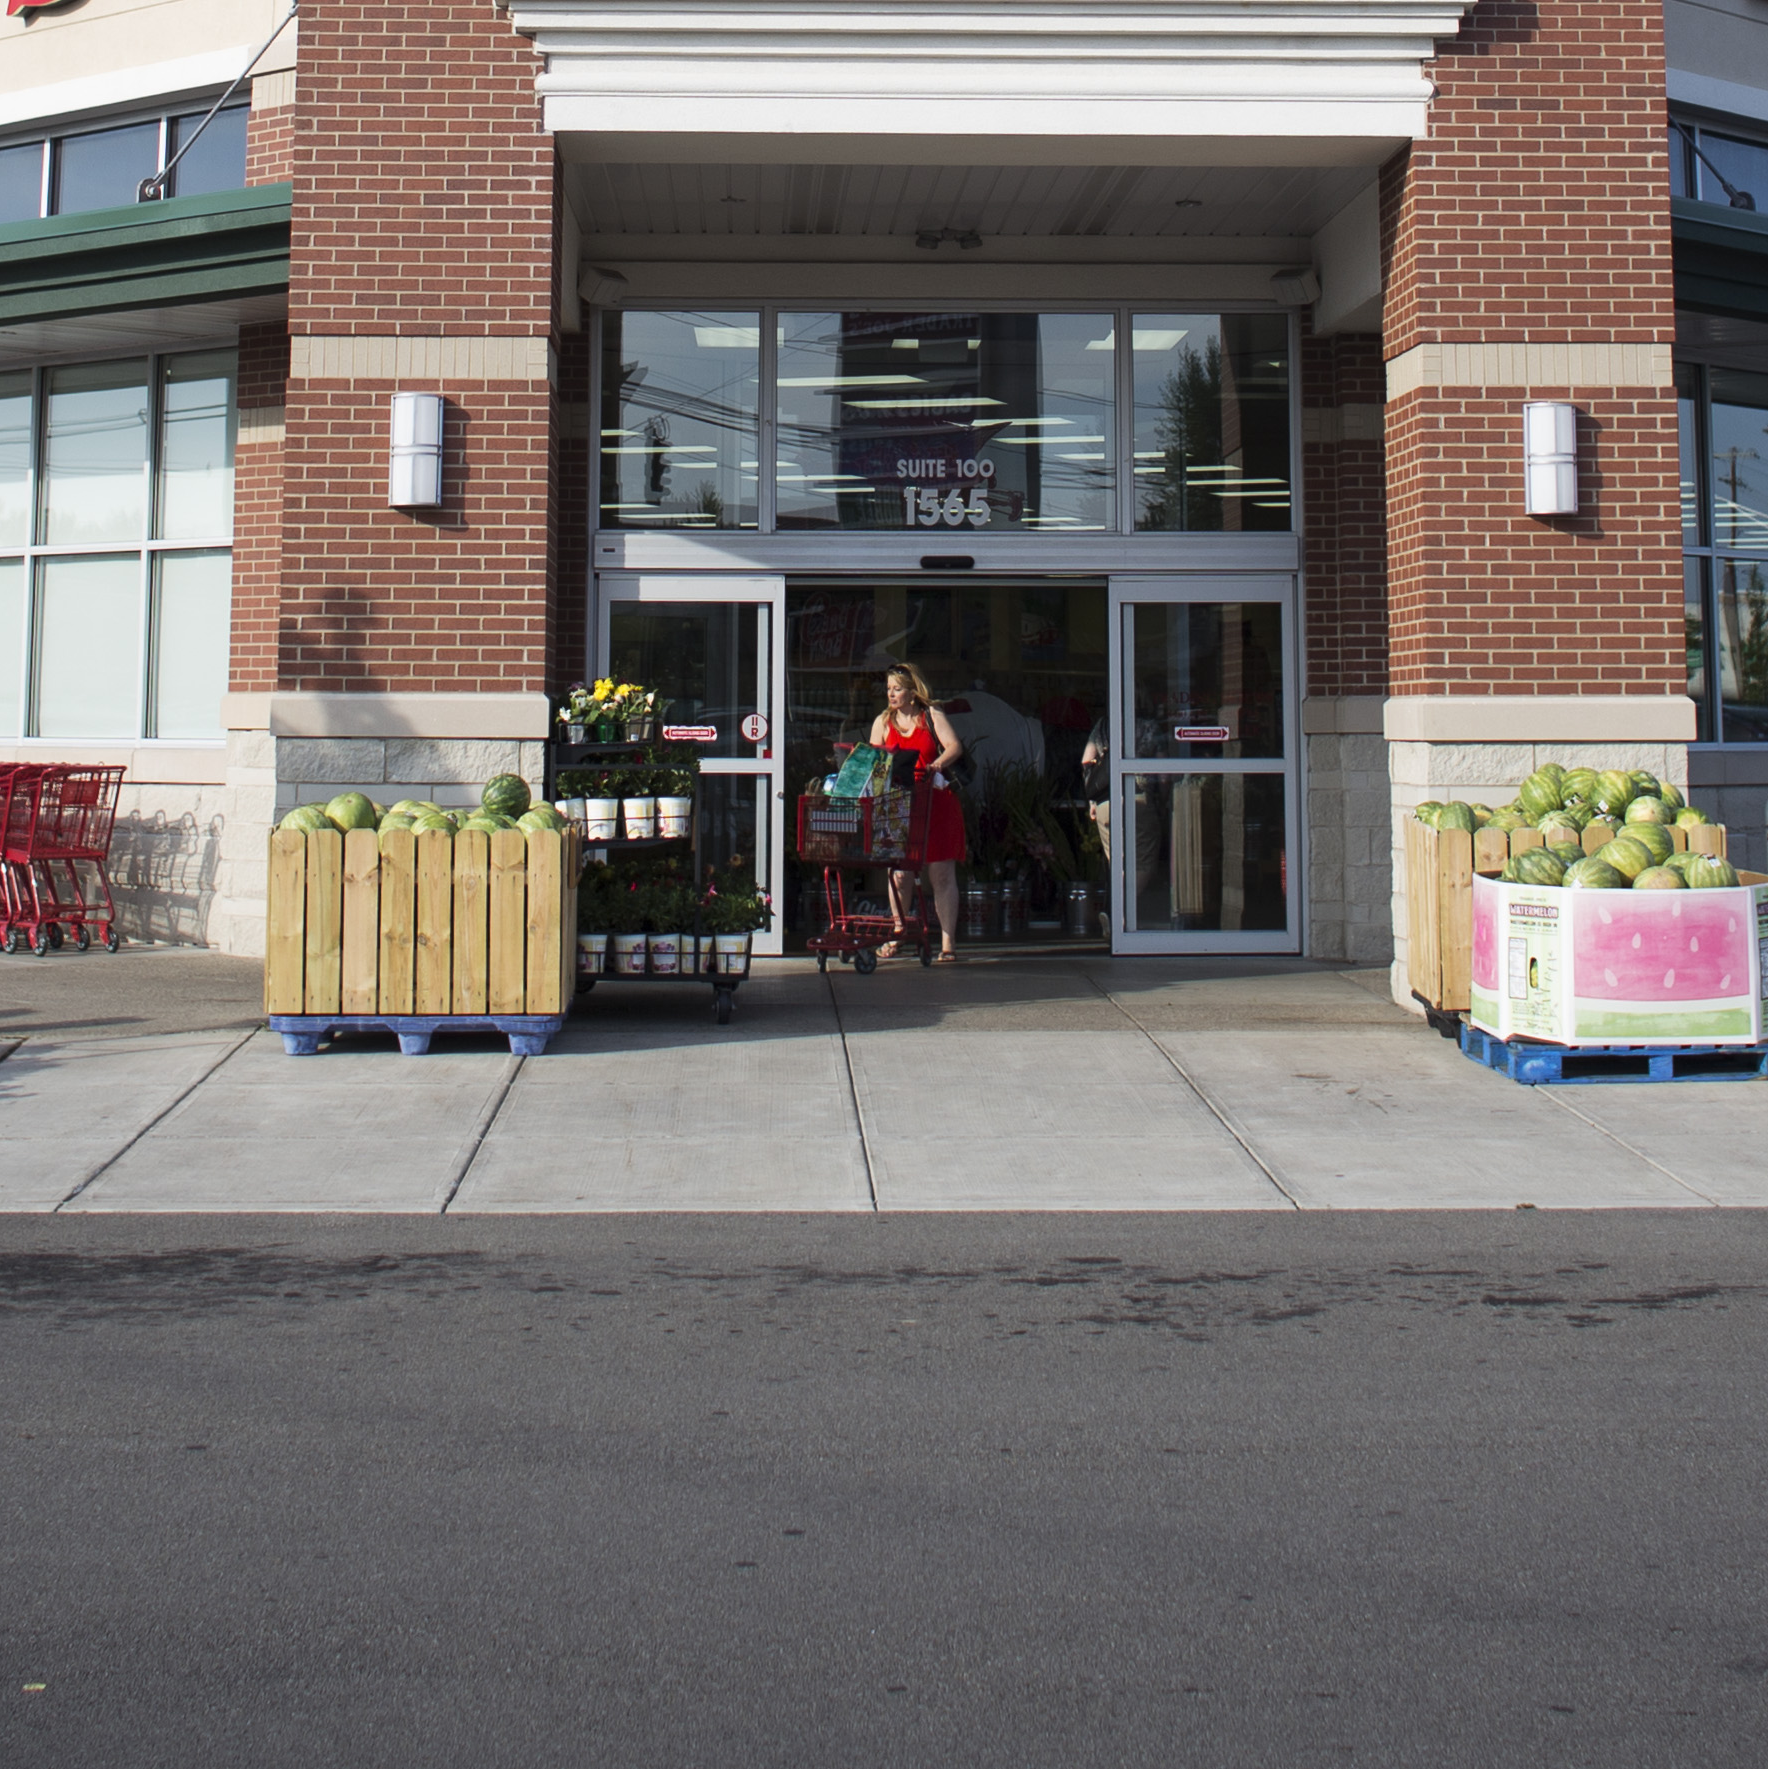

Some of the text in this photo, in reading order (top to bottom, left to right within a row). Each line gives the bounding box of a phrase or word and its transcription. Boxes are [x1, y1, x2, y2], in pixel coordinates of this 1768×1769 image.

[896, 458, 995, 479] SUITE 100
[903, 487, 992, 527] 1565
[751, 727, 759, 738] R
[1511, 904, 1558, 918] WATERMELON
